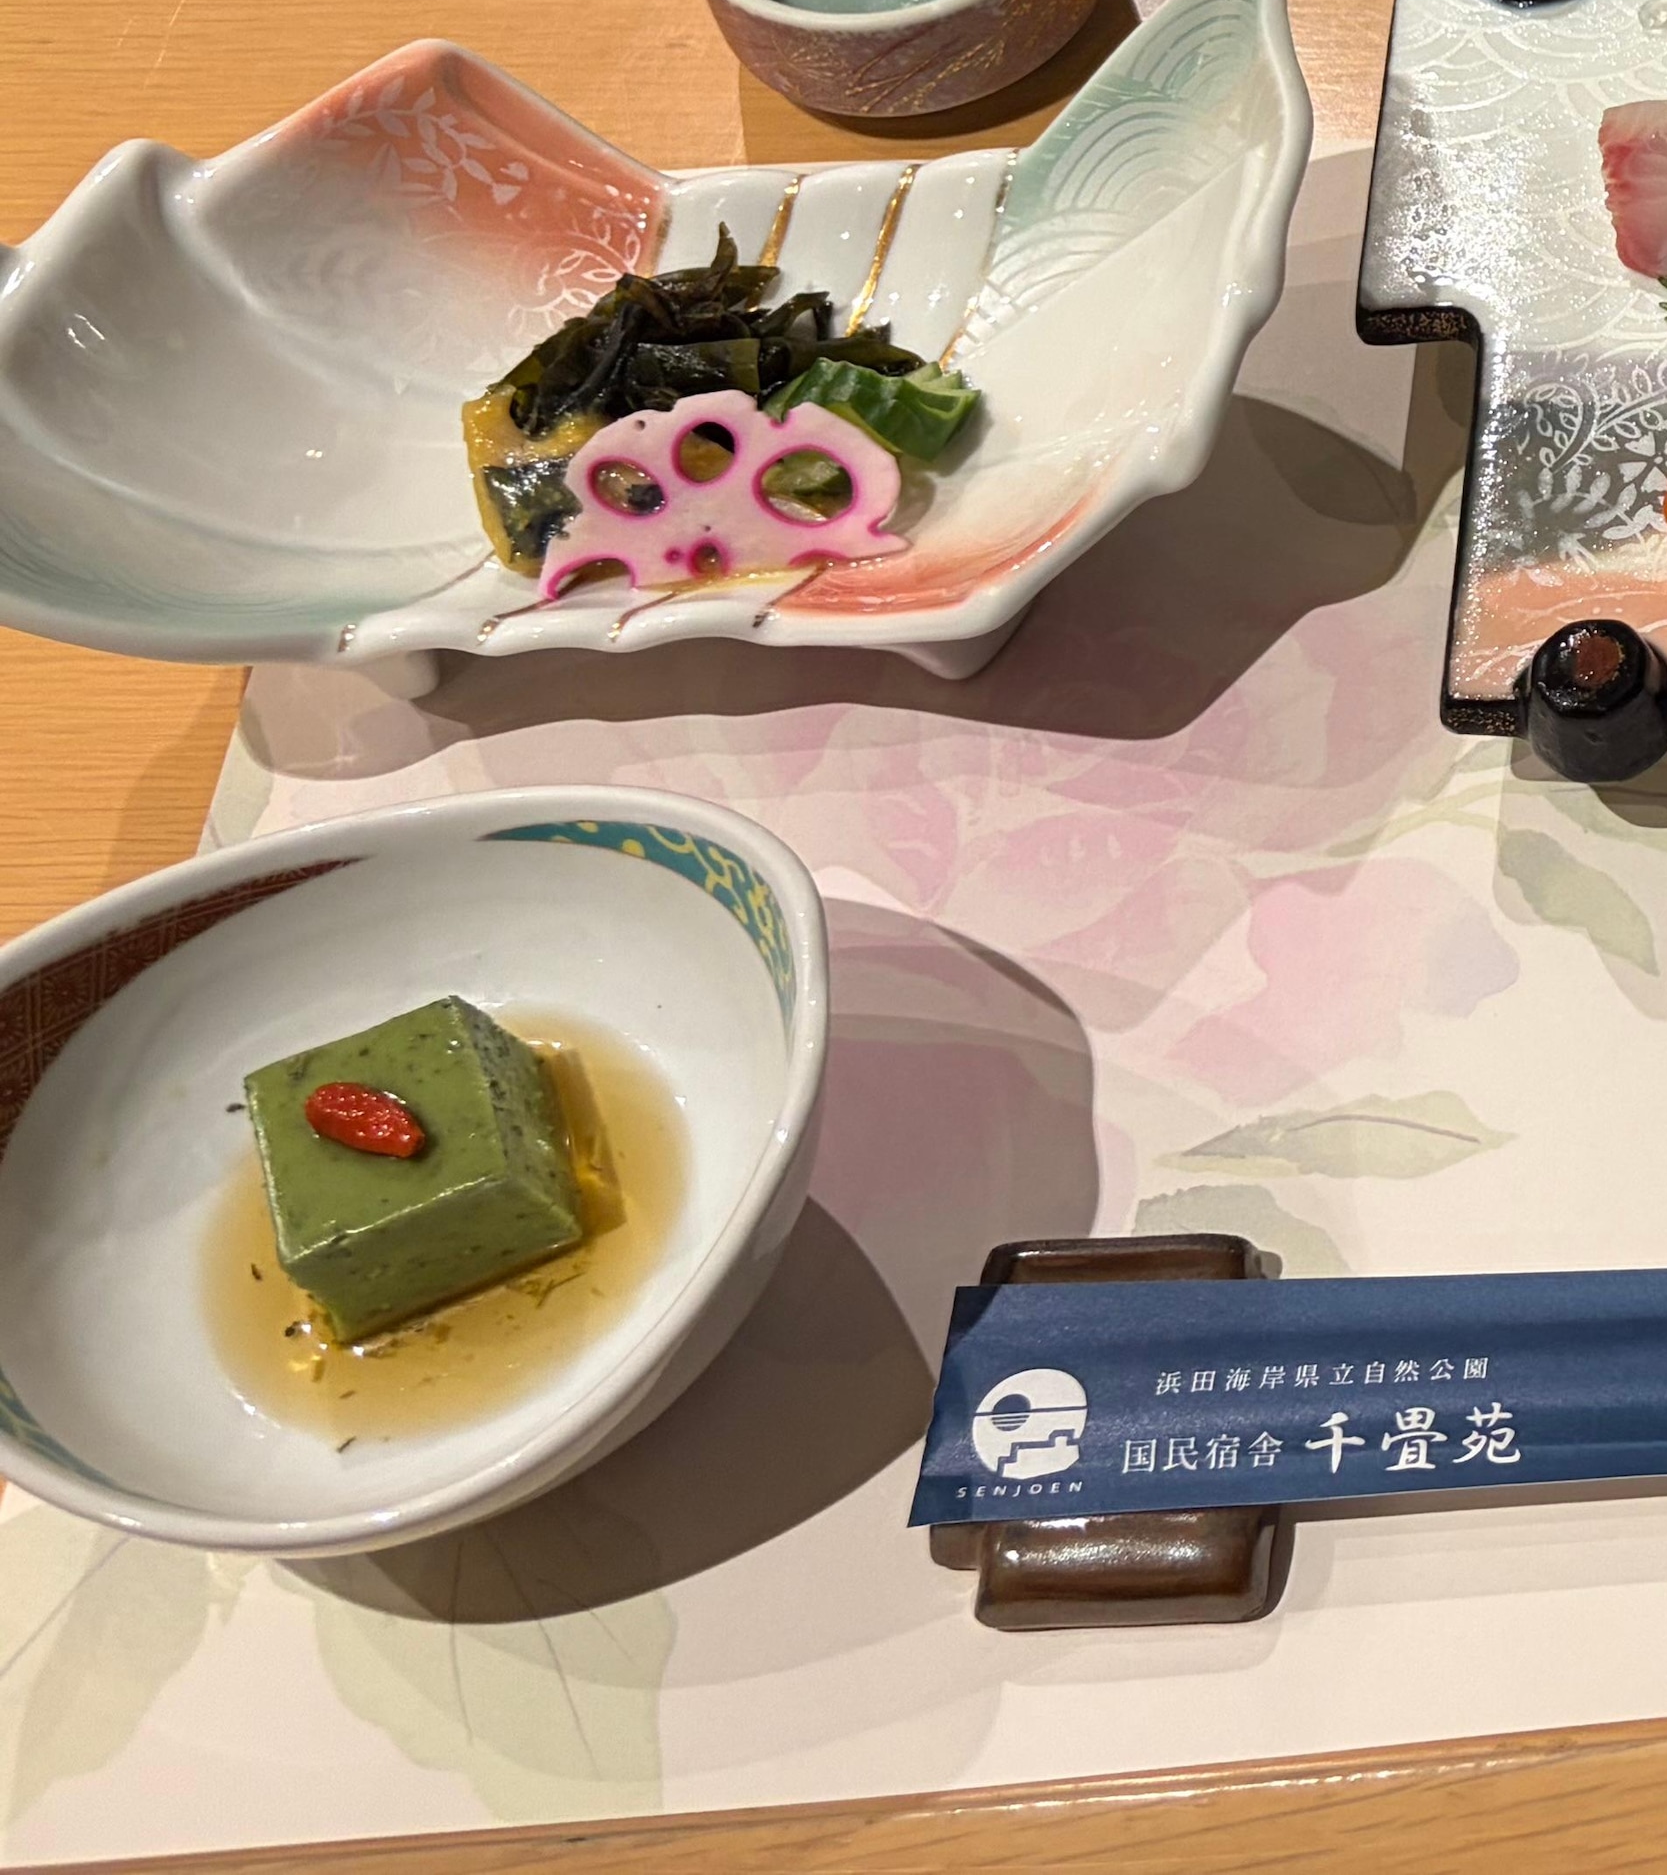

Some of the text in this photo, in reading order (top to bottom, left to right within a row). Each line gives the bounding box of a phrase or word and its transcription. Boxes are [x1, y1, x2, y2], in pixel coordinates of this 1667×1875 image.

[1156, 1355, 1490, 1396] 浜田海岸県立自然公園
[1122, 1400, 1523, 1476] 国民宿舎 千畳苑
[956, 1479, 1085, 1499] SENJOEN
